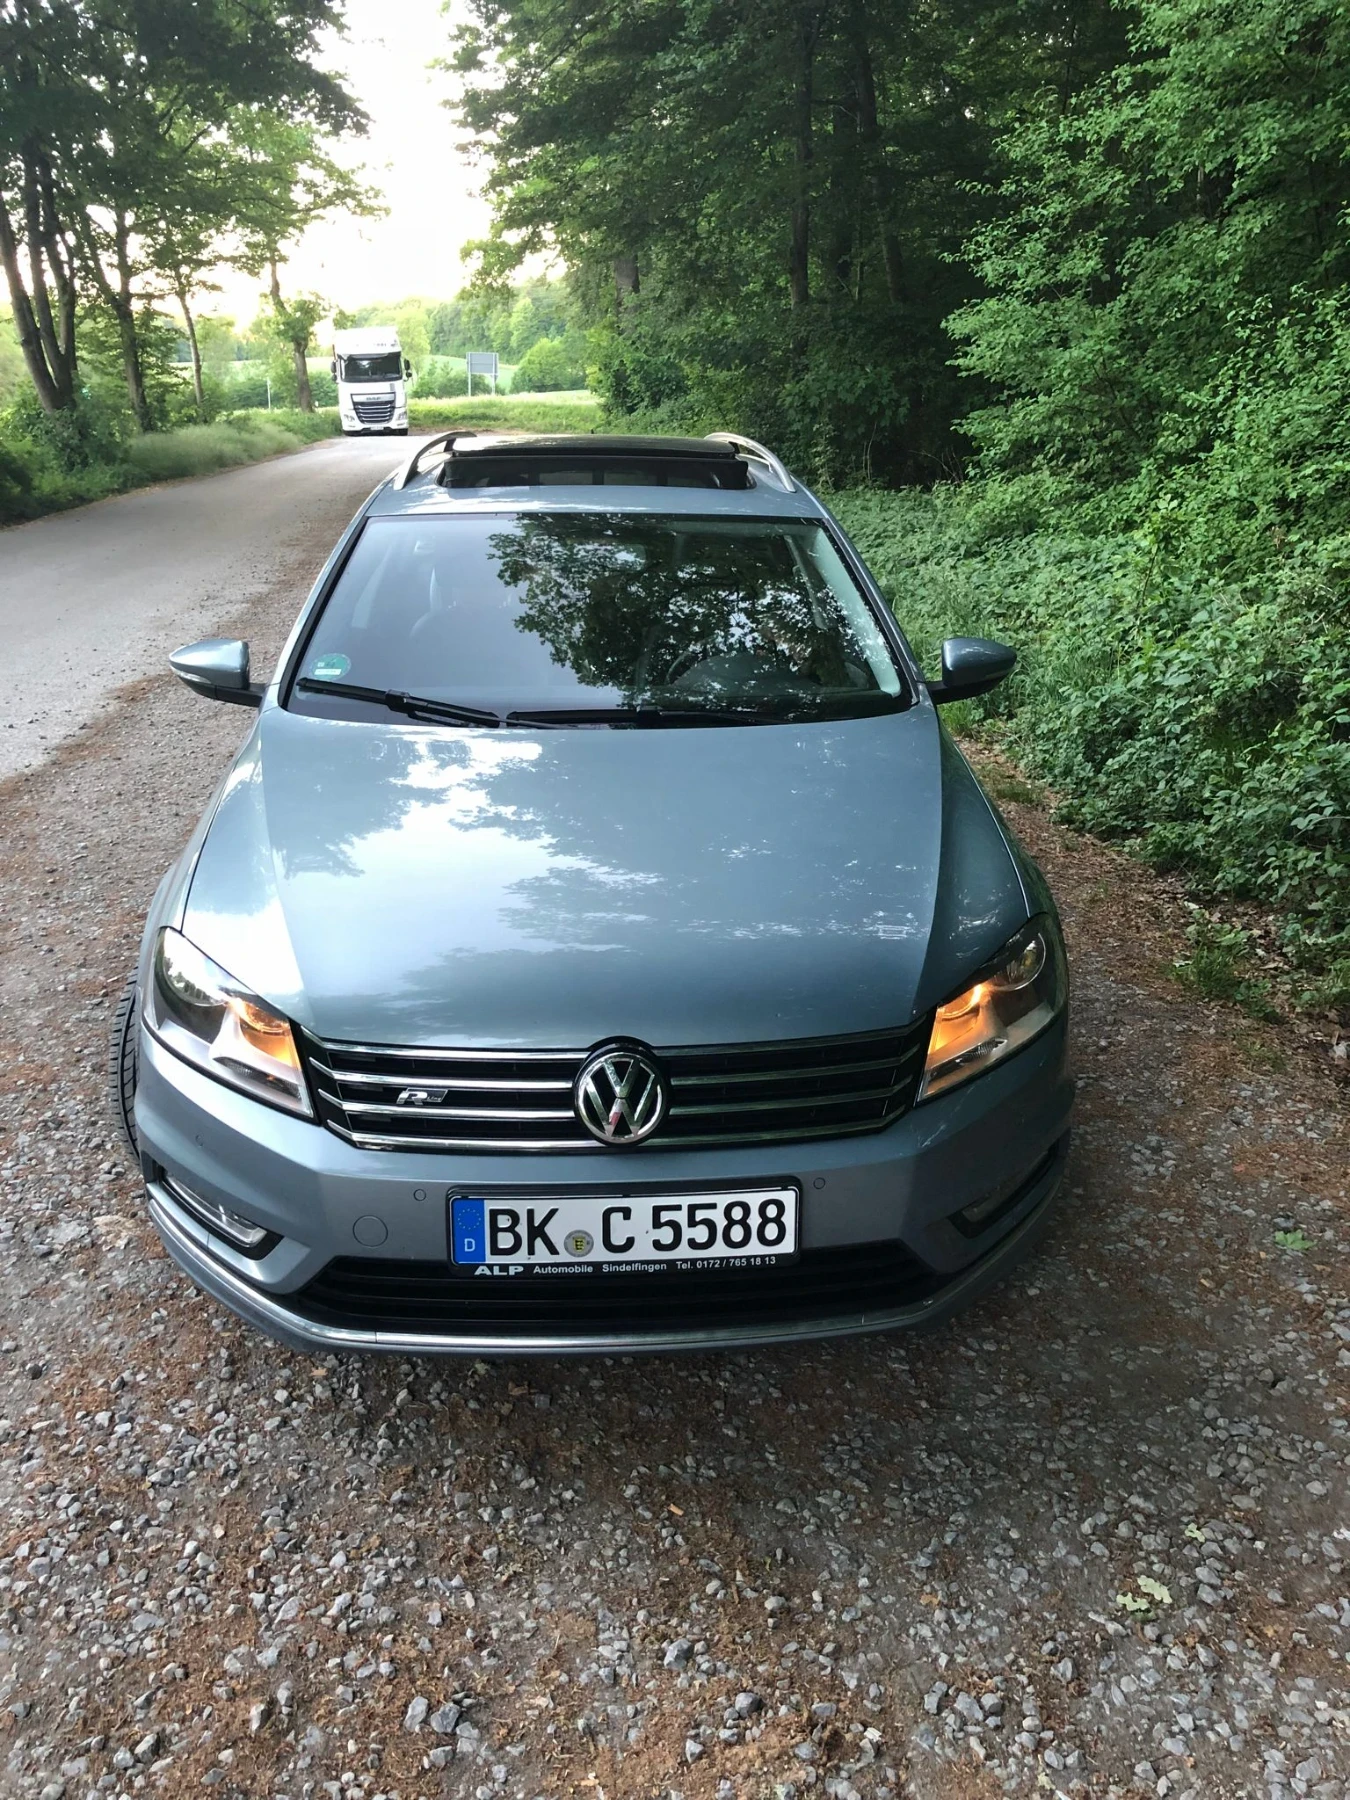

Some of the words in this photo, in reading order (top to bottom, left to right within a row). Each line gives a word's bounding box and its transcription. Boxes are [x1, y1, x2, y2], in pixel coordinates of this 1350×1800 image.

[489, 1208, 560, 1256] BK
[601, 1206, 636, 1254] C
[652, 1198, 787, 1252] 5588
[464, 1238, 476, 1252] D
[474, 1265, 525, 1276] ALP
[532, 1264, 594, 1274] Automobile
[602, 1261, 668, 1273] Sindelfingen
[676, 1260, 694, 1270] Tel.
[696, 1259, 721, 1269] 0172
[729, 1258, 748, 1267] 765
[750, 1257, 762, 1266] 18
[764, 1256, 776, 1265] 13
